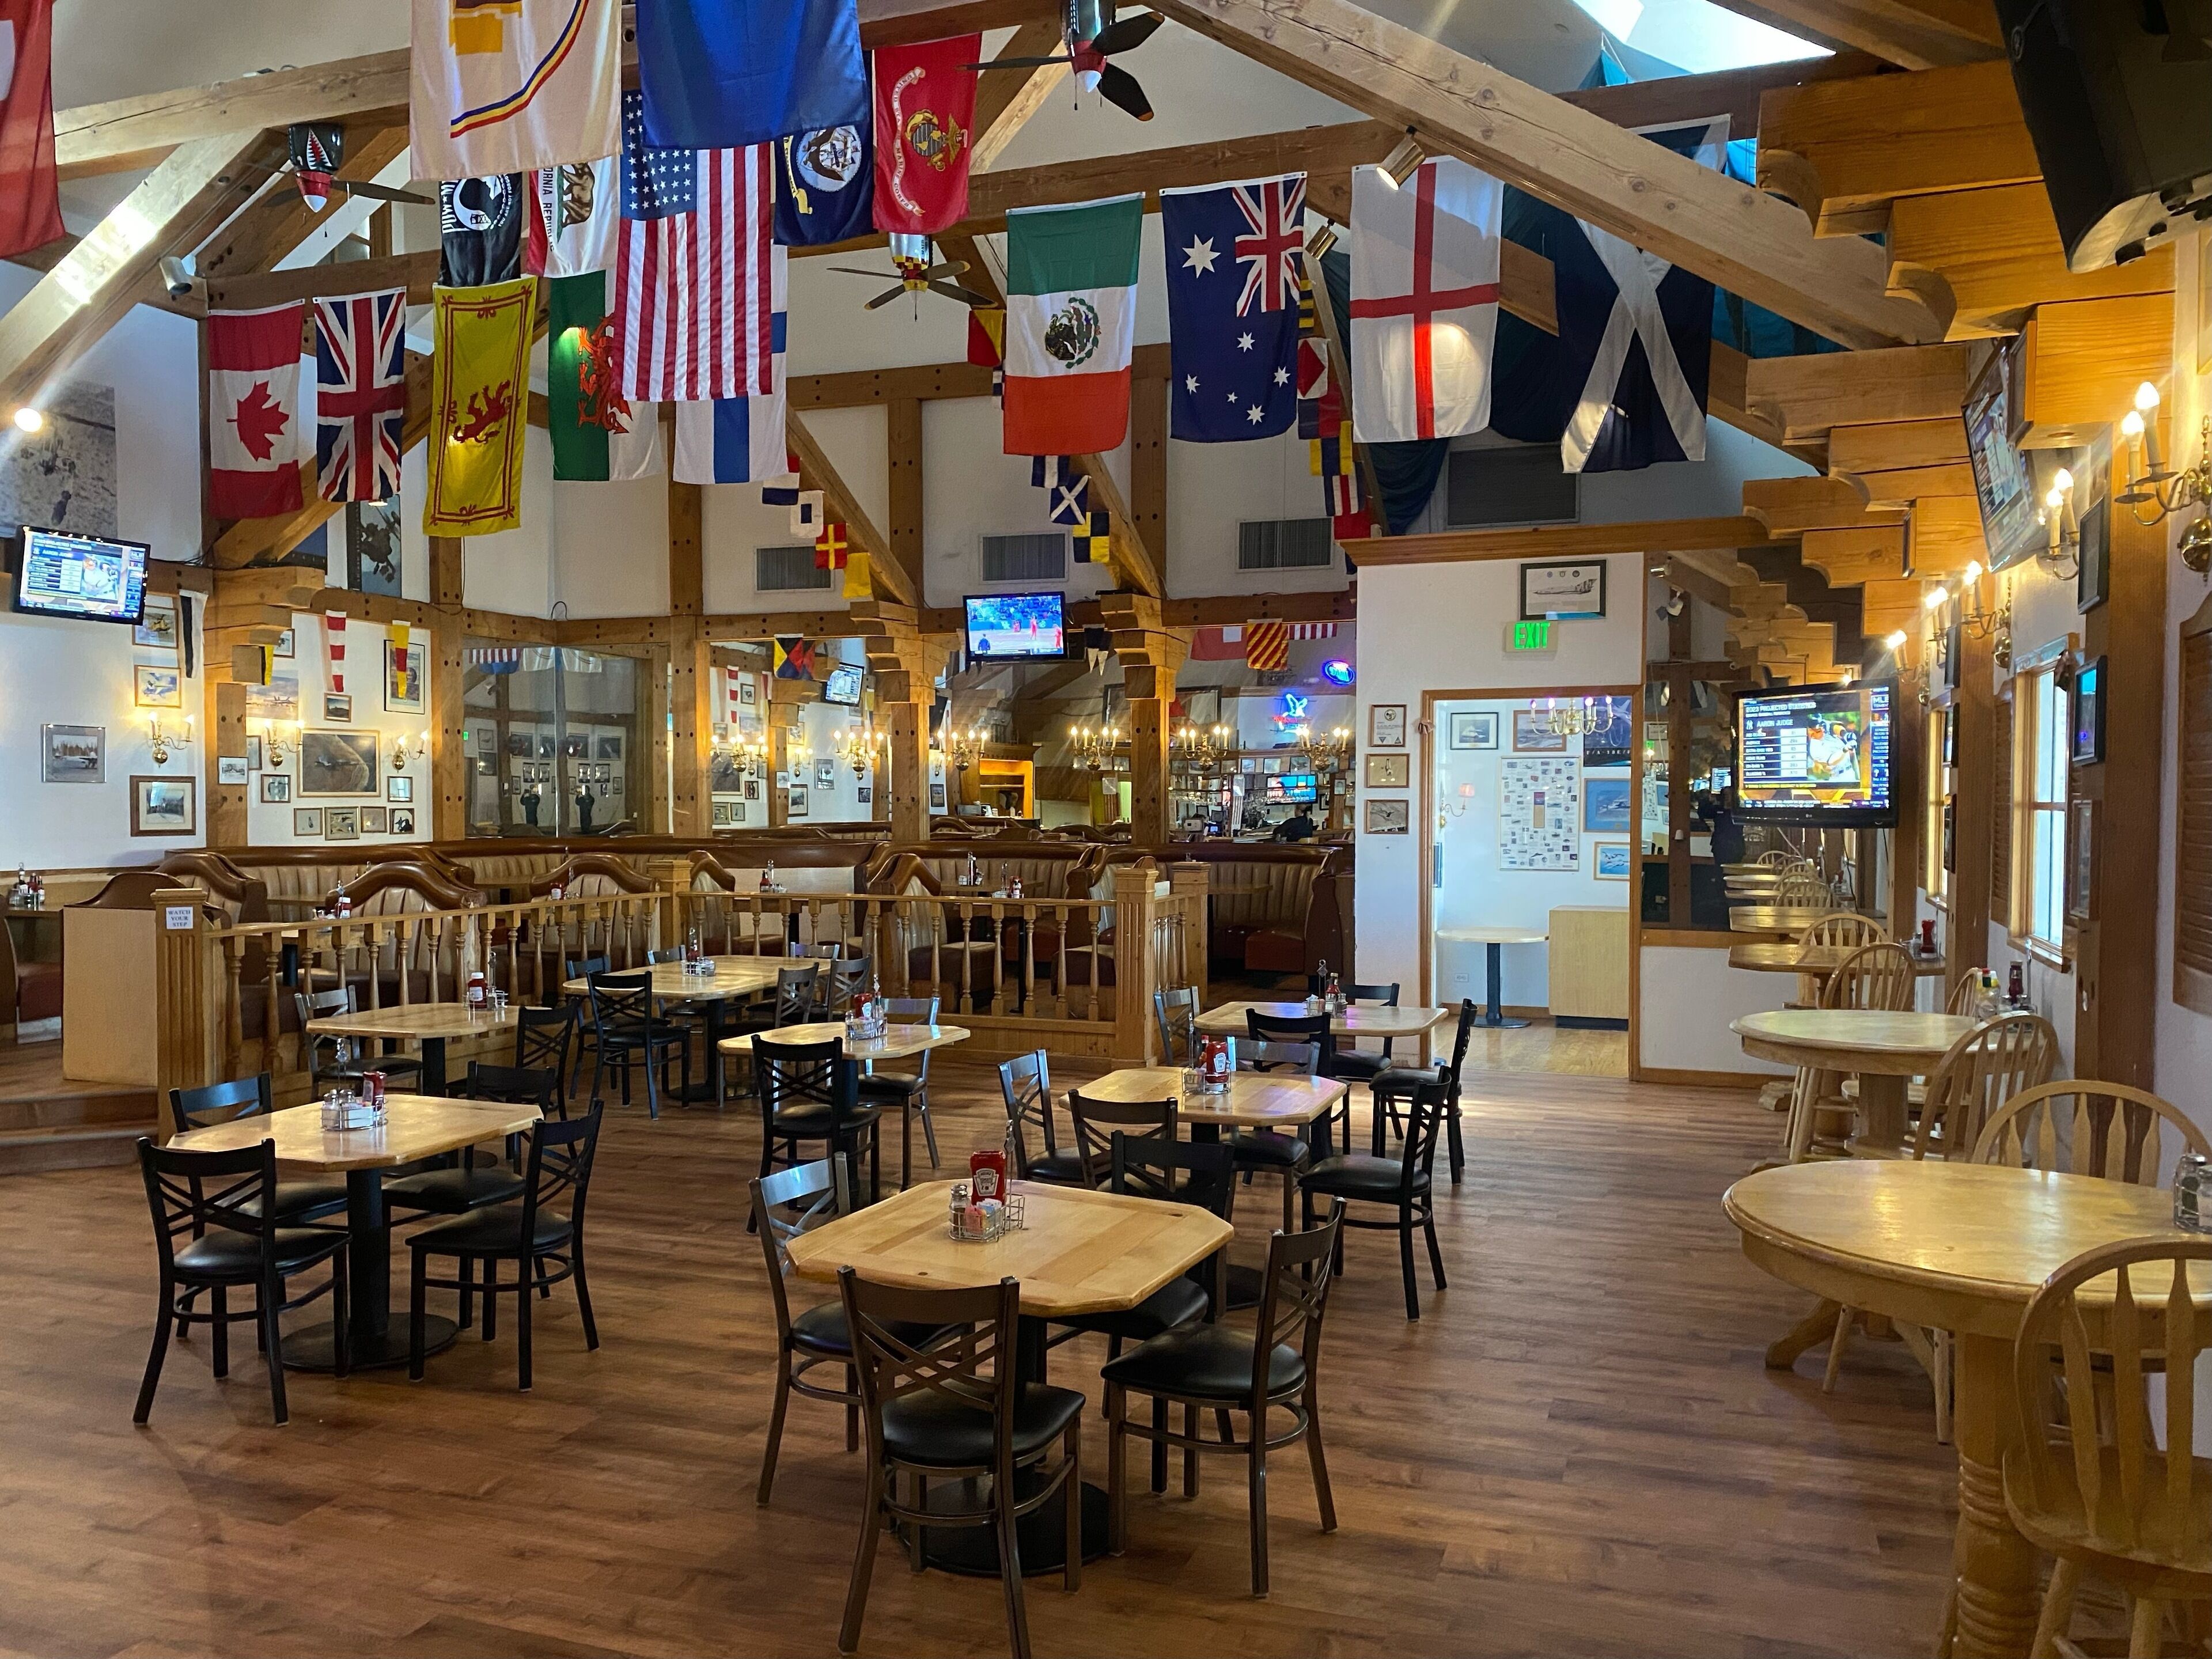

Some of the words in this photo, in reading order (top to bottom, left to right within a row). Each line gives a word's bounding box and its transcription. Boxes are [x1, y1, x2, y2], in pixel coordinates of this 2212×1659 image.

[543, 167, 554, 195] ORNIA
[498, 217, 506, 227] YOU
[504, 175, 512, 194] FORGO
[1514, 622, 1551, 649] EXIT
